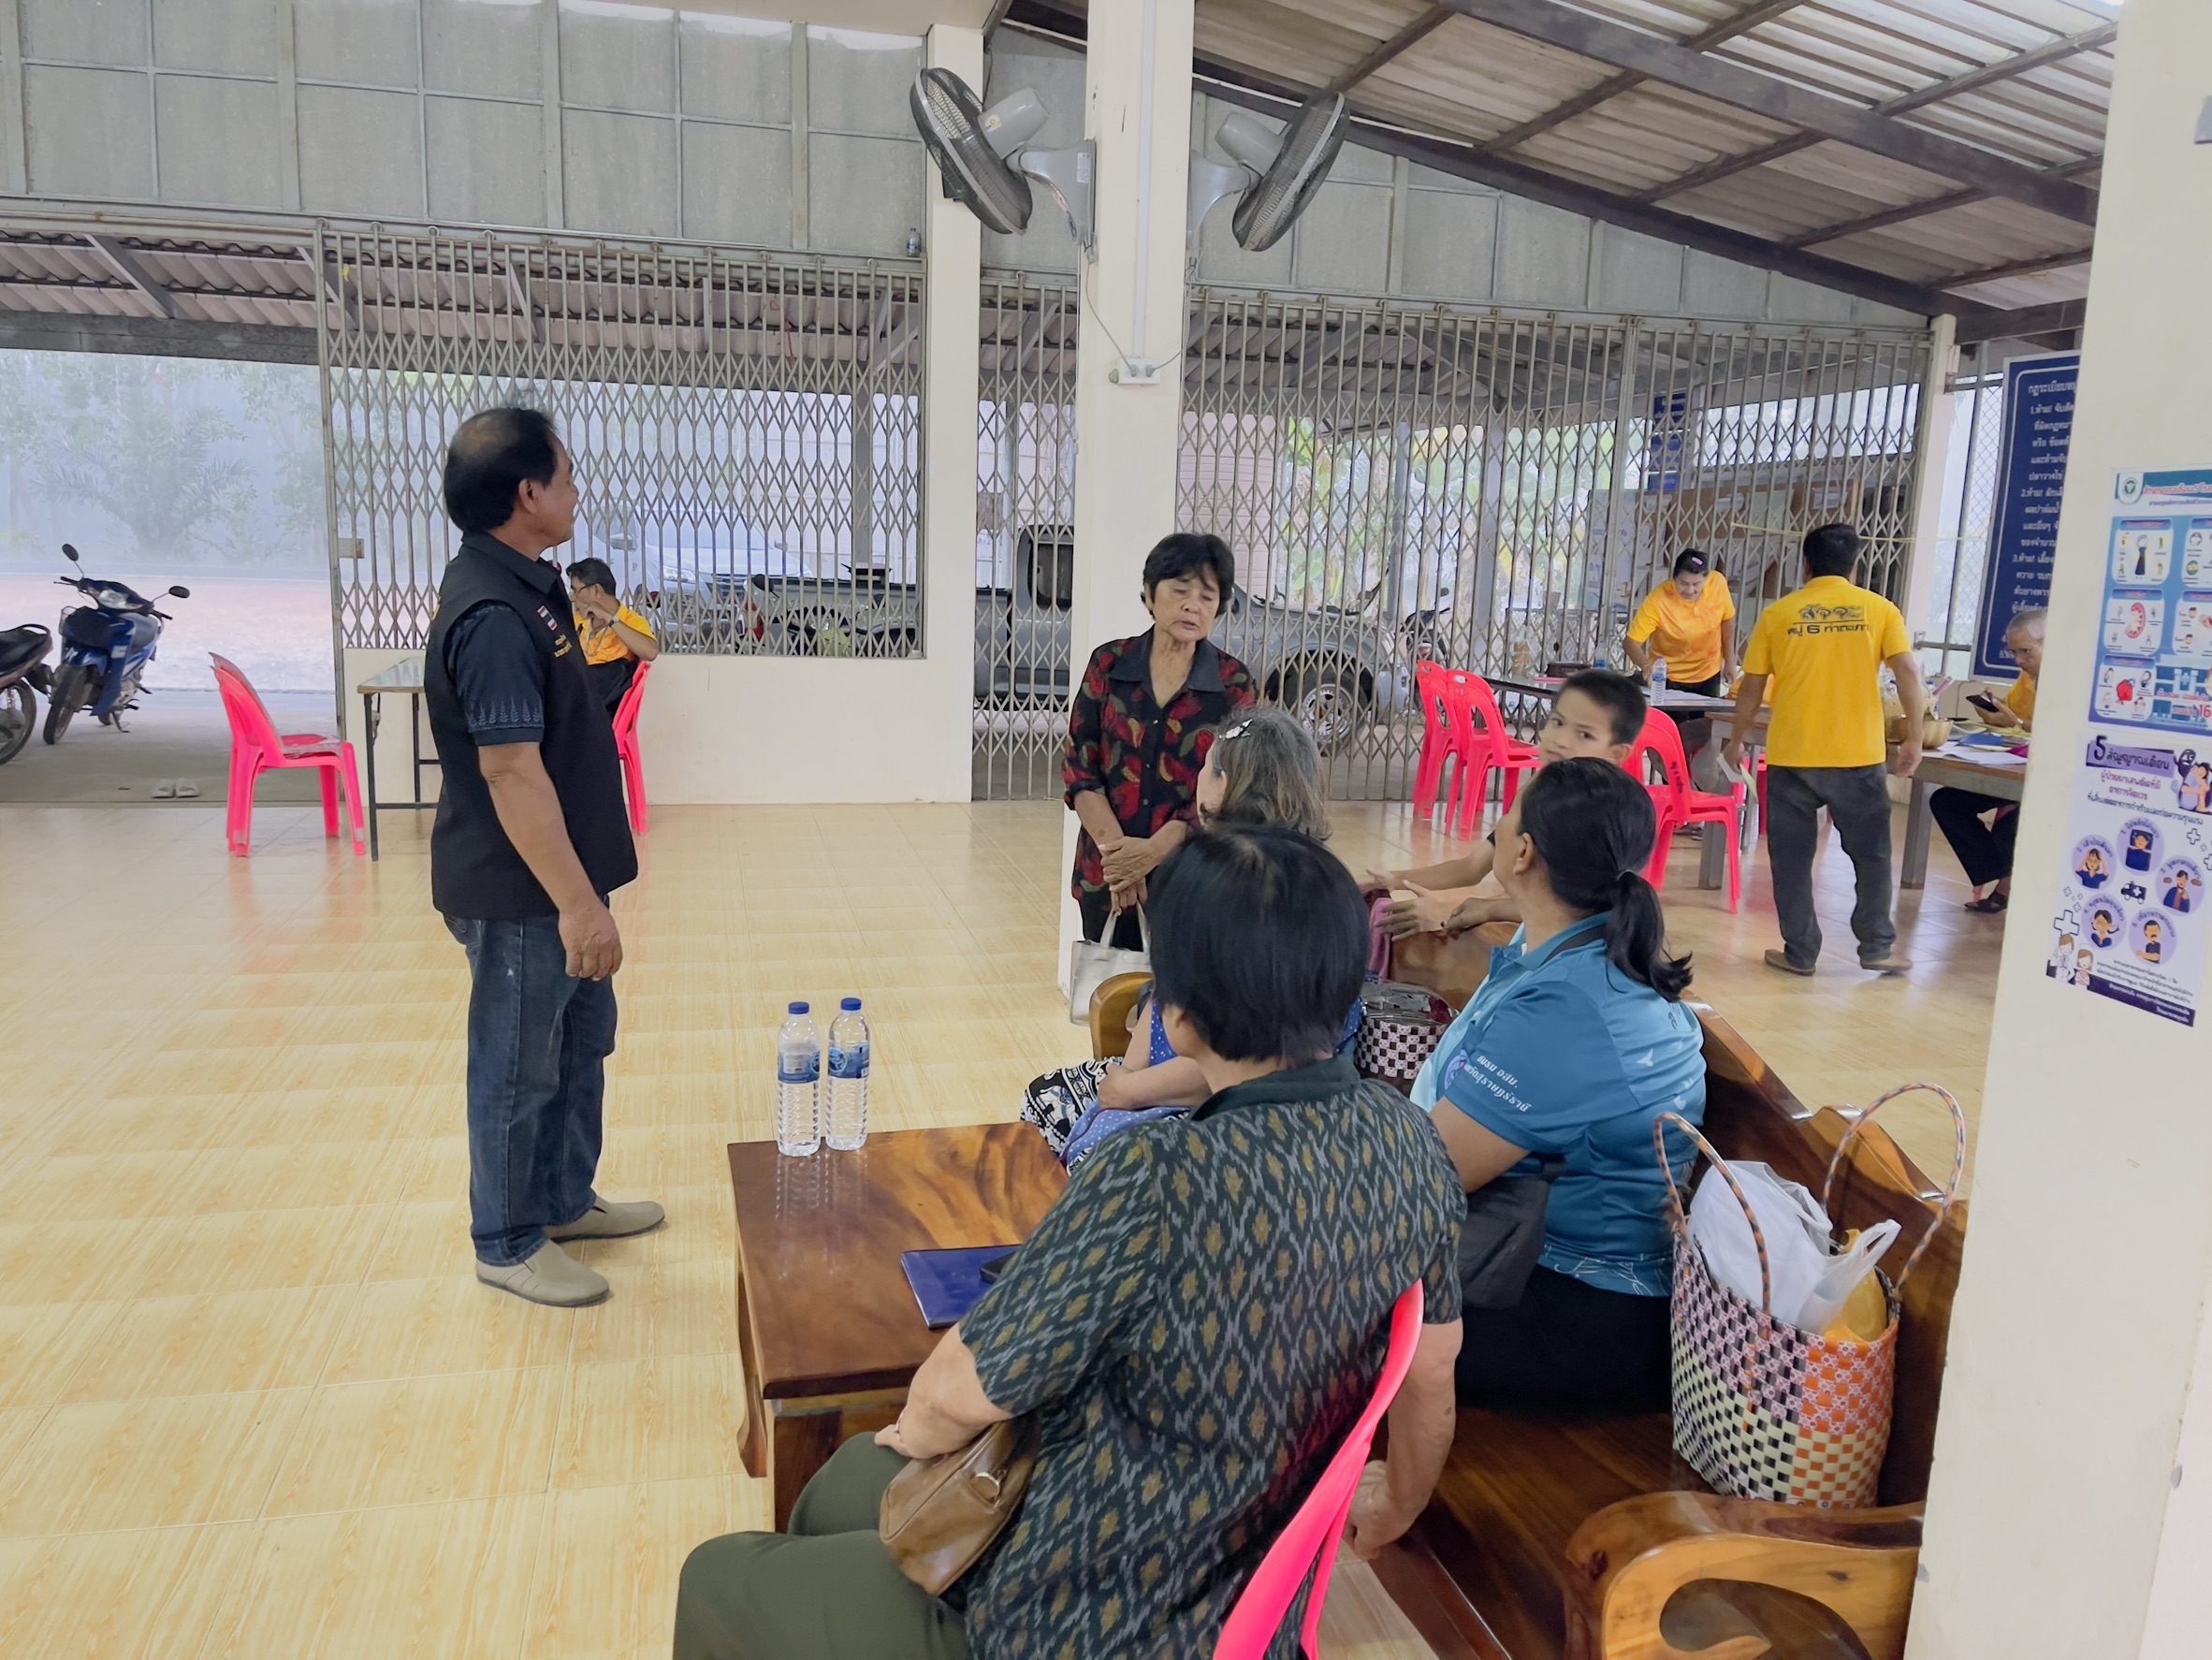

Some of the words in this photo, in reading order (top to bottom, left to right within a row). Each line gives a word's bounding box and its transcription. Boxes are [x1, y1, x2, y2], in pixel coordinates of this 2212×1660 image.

[1807, 624, 1821, 633] 6
[2094, 735, 2107, 761] 5
[2106, 748, 2170, 771] สัญญาณเตือน
[1496, 1069, 1519, 1088] อสม.
